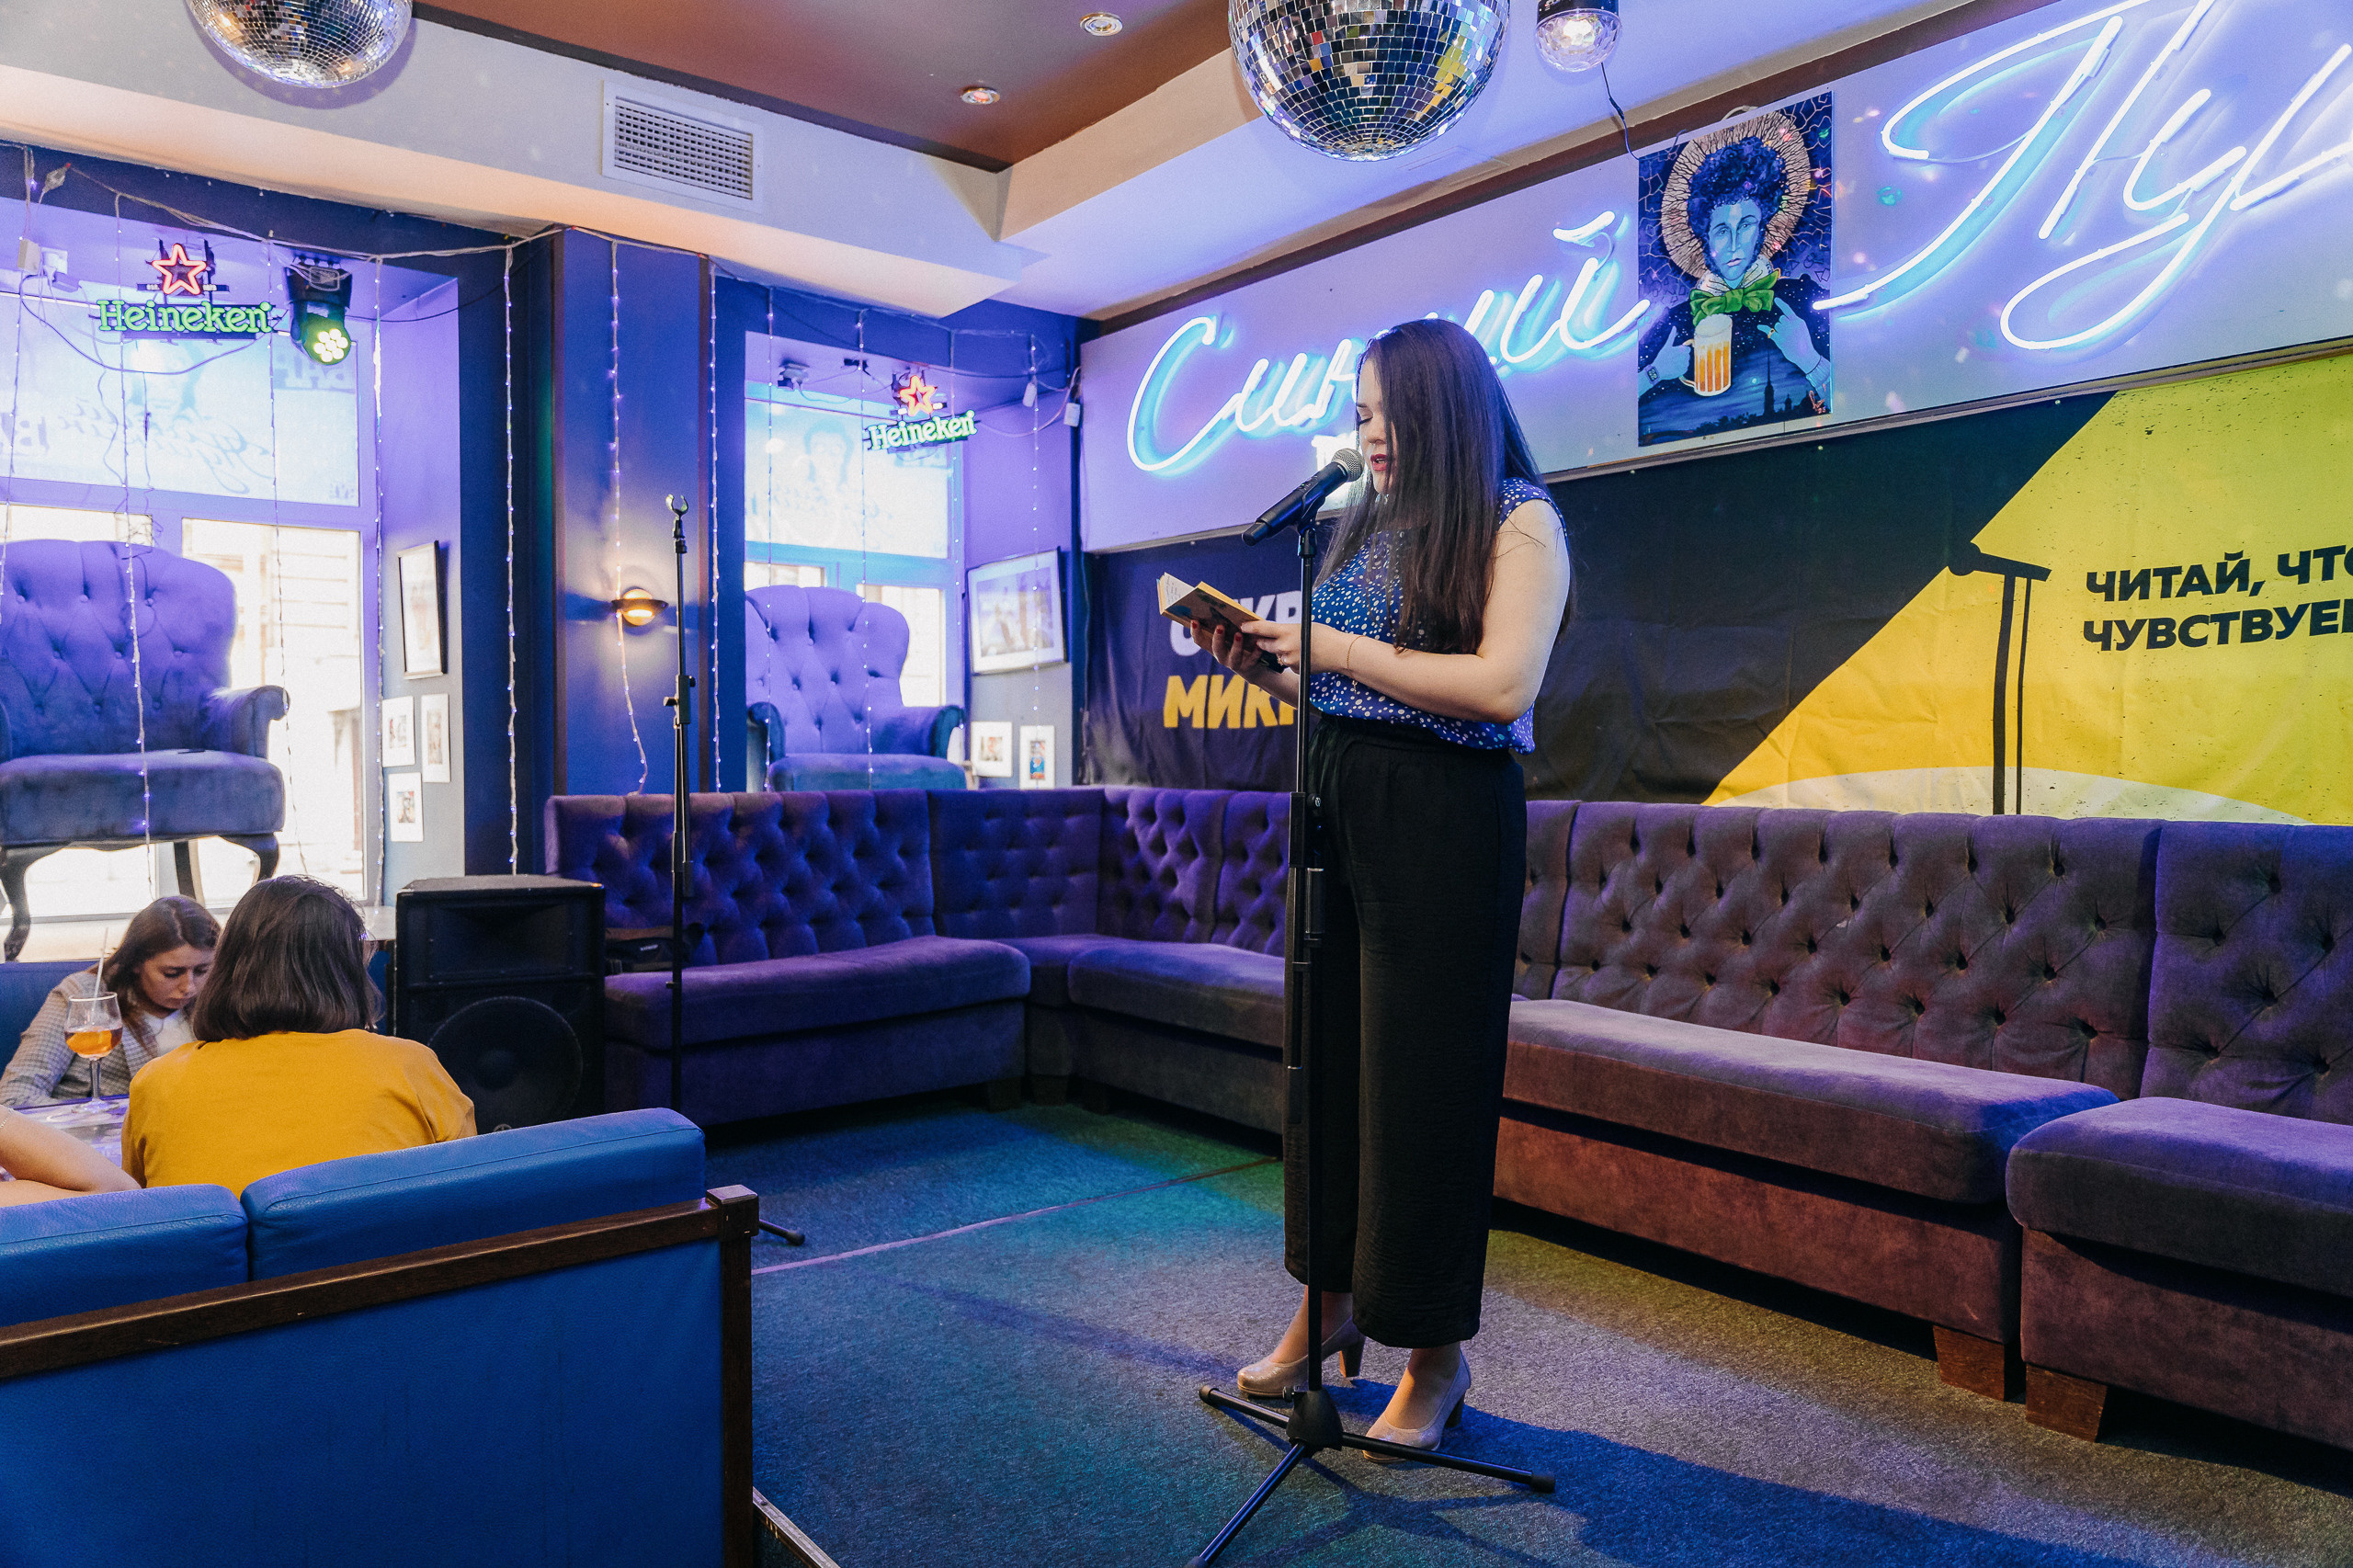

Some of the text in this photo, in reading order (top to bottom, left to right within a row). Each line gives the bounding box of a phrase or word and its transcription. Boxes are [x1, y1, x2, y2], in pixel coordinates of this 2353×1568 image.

[97, 300, 272, 334] Heineken
[868, 410, 978, 450] Heineken
[2086, 544, 2353, 602] ЧИТАЙ, ЧТ
[2083, 598, 2353, 652] ЧУВСТВУЕ
